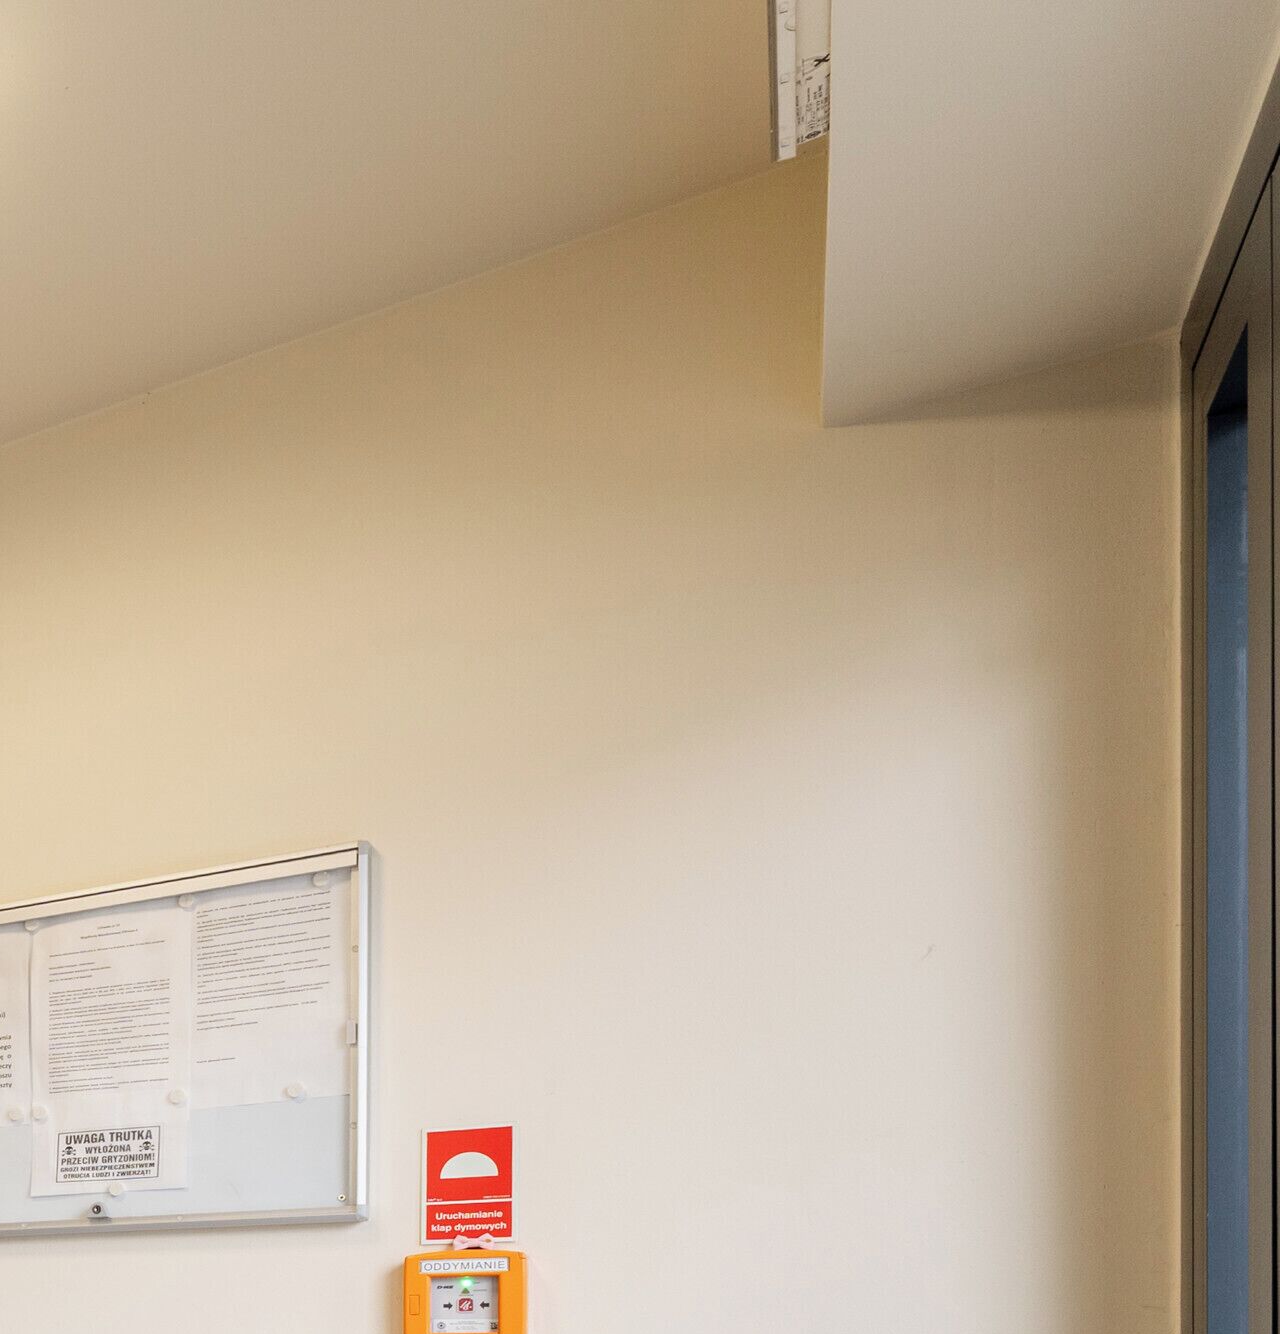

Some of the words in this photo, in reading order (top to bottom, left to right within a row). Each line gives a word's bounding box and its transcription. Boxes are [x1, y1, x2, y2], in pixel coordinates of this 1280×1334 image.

[65, 1132, 106, 1145] UWAGA
[109, 1130, 152, 1142] TRUTKA
[85, 1144, 132, 1154] WYŁOŻONA
[61, 1156, 99, 1166] PRZECIW
[102, 1153, 154, 1164] GRYZONIOM!
[436, 1210, 503, 1220] Uruchamianie
[431, 1224, 452, 1232] klap
[454, 1222, 506, 1232] dymowych
[424, 1260, 506, 1271] ODDYMIANIE
